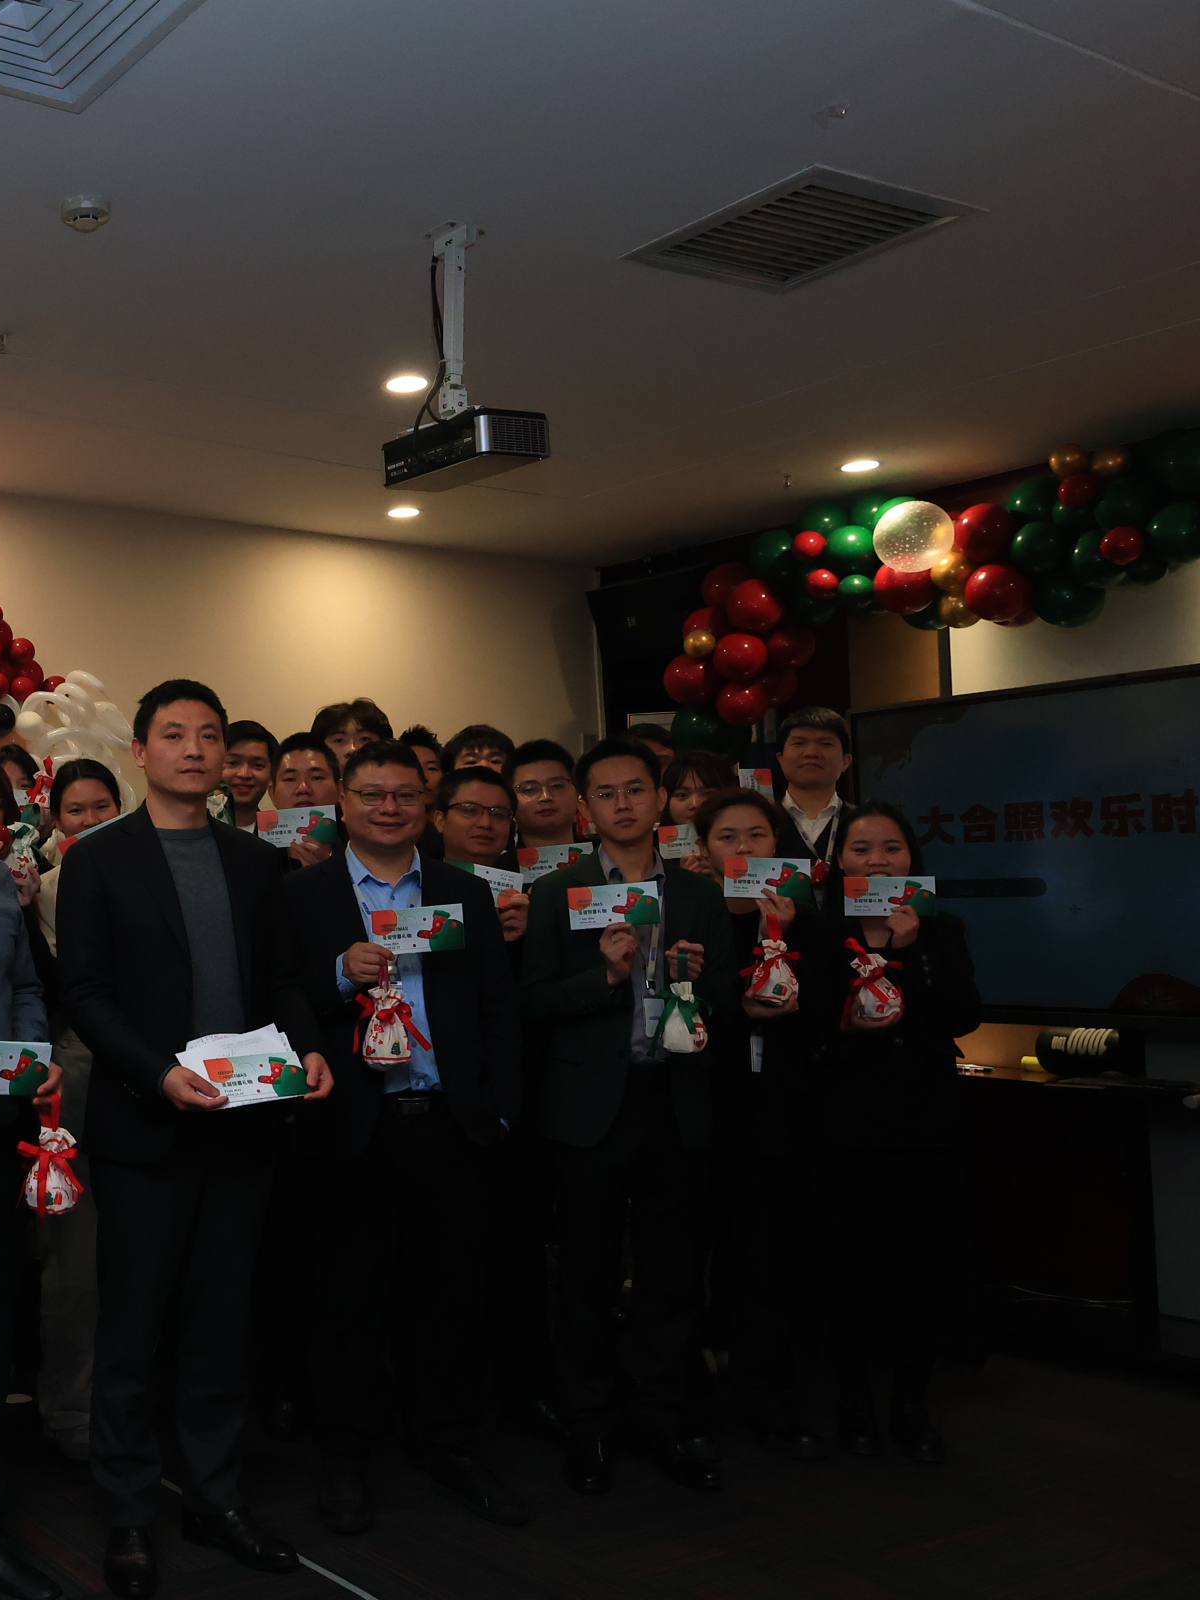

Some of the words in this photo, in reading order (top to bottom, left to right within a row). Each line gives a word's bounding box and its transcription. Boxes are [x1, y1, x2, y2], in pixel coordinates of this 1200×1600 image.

[917, 788, 1199, 846] 大合照欢乐时
